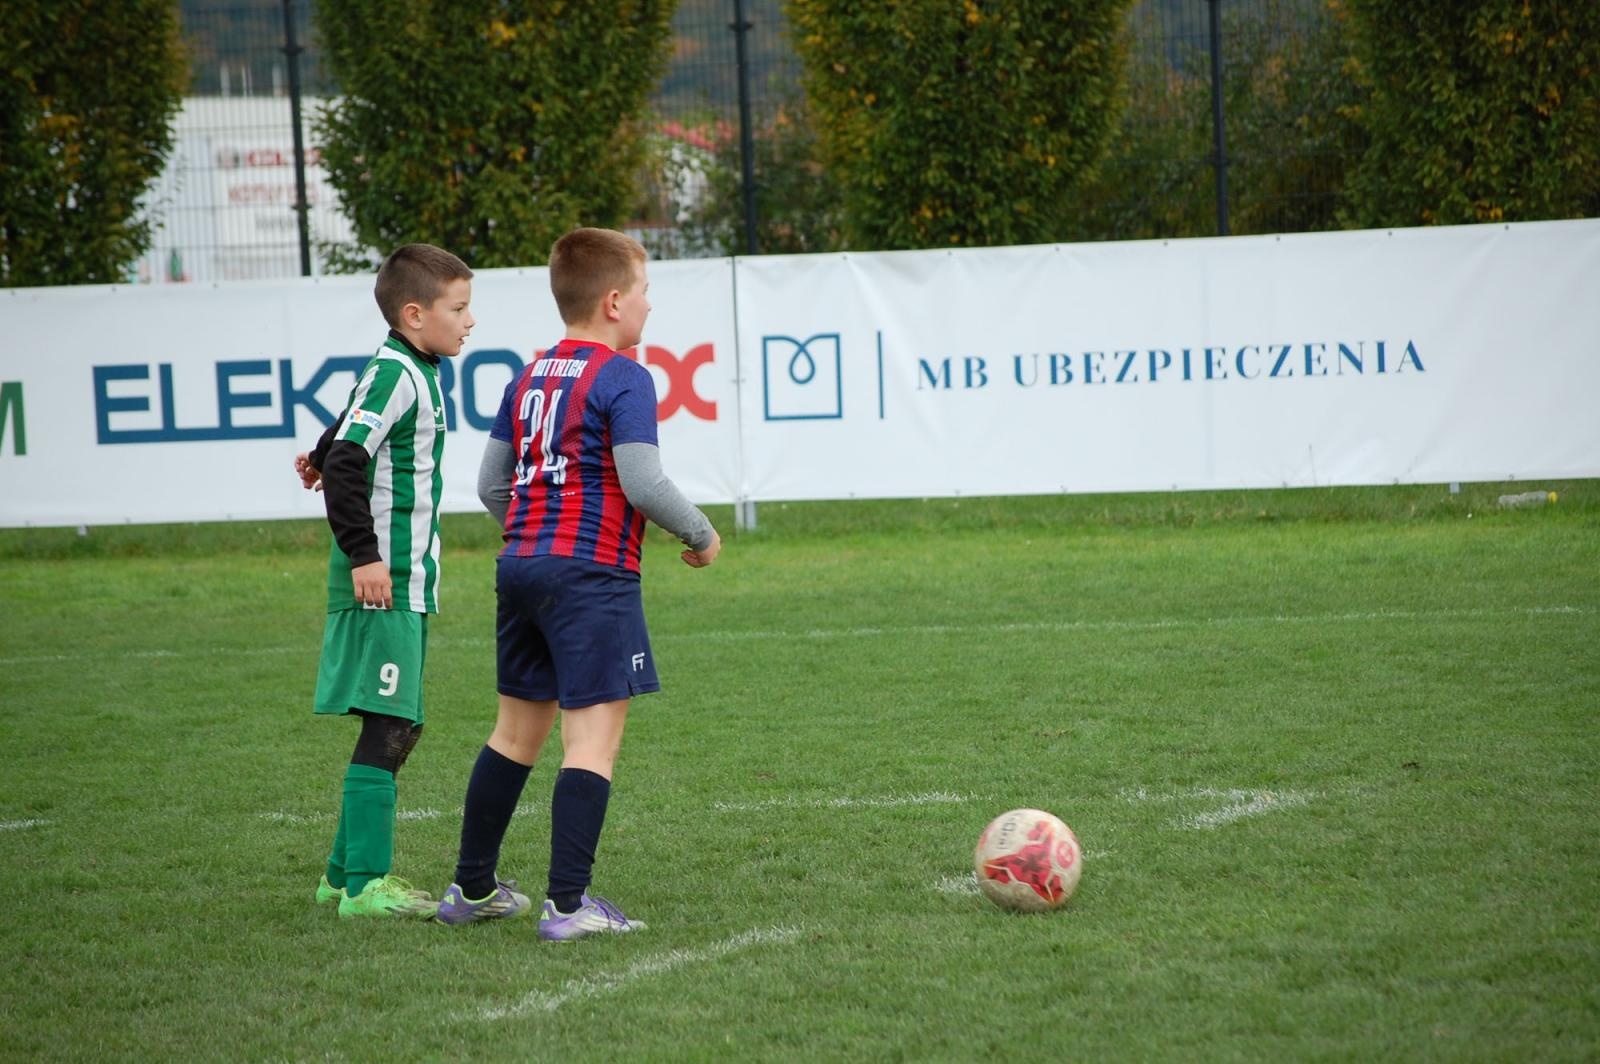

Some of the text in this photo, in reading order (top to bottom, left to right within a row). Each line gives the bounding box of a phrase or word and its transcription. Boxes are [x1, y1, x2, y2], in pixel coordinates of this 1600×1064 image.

[917, 339, 1426, 390] MB UBEZPIECZENIA
[516, 388, 568, 486] 24
[378, 663, 399, 697] 9
